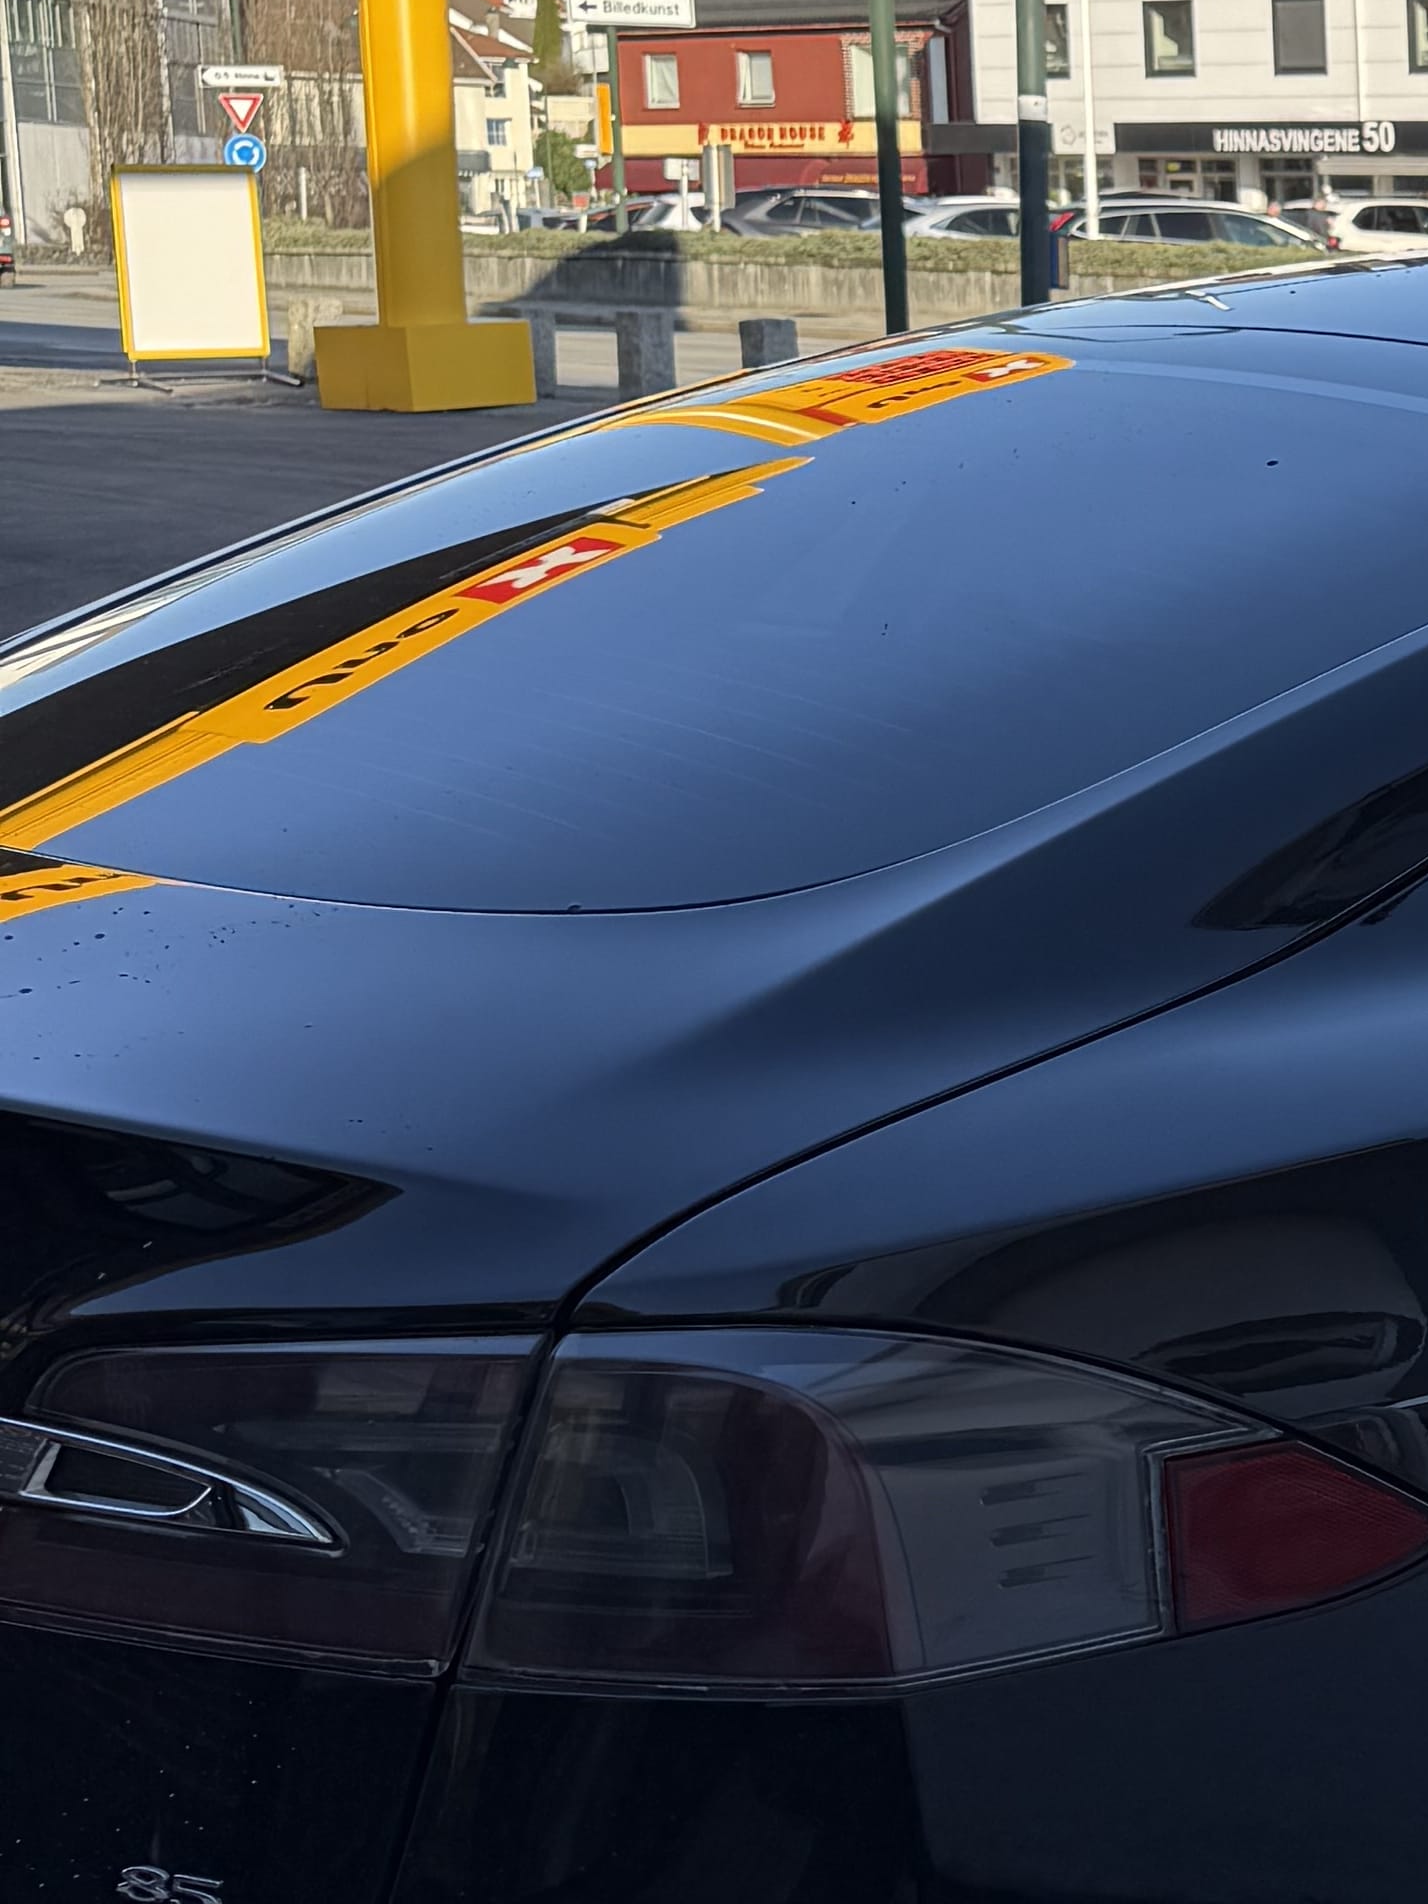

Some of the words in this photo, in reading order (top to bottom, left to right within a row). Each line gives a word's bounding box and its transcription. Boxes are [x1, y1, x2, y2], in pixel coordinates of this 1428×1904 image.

[603, 0, 680, 16] Billedkunst
[1213, 128, 1360, 153] HINNASVINGENE
[1362, 121, 1395, 153] 50
